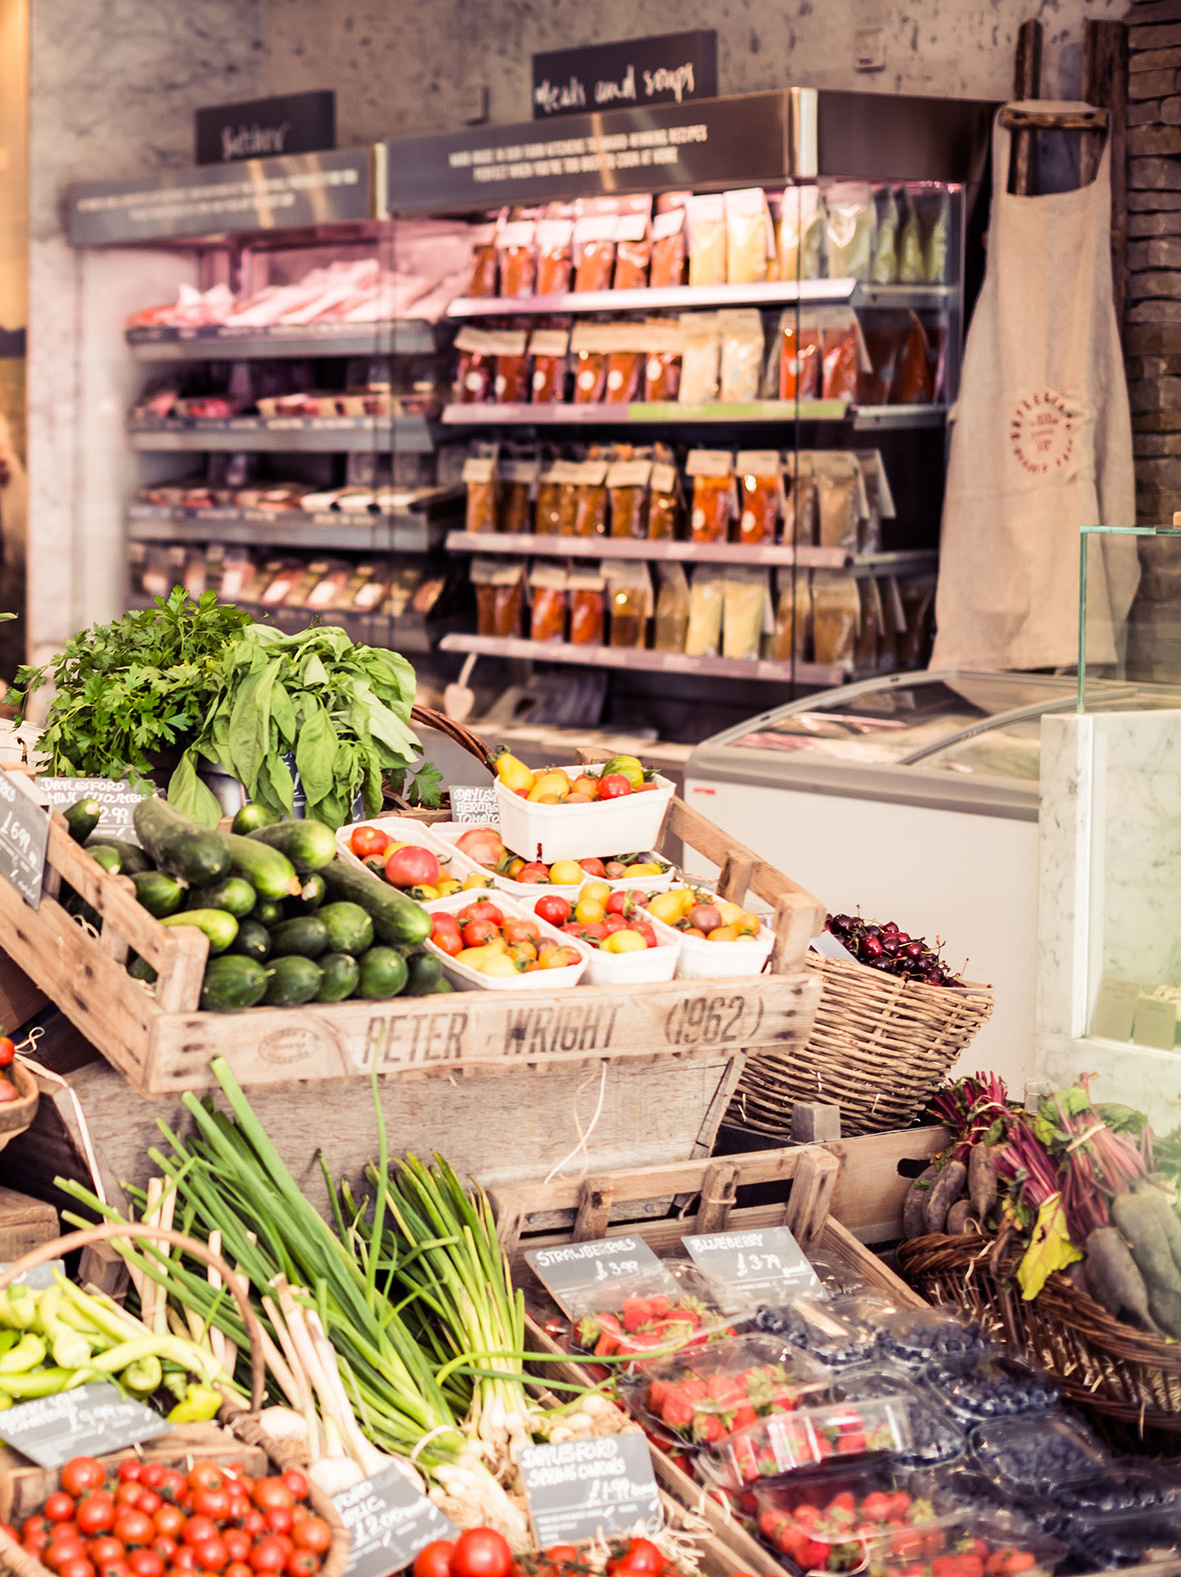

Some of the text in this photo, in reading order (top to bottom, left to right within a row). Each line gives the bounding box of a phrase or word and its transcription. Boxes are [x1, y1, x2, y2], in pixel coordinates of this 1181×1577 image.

[595, 64, 637, 104] and
[642, 61, 696, 104] soups
[40, 778, 126, 793] DAYLESFORD
[453, 787, 498, 803] DAYLES
[98, 805, 130, 825] 2.99
[455, 801, 500, 814] HERITAG
[456, 812, 500, 824] TOMATO
[362, 1012, 469, 1065] PETER
[503, 1002, 624, 1056] WRIGHT
[535, 1237, 637, 1267] STRAWBERRIES
[689, 1232, 765, 1254] BLUEBERRY
